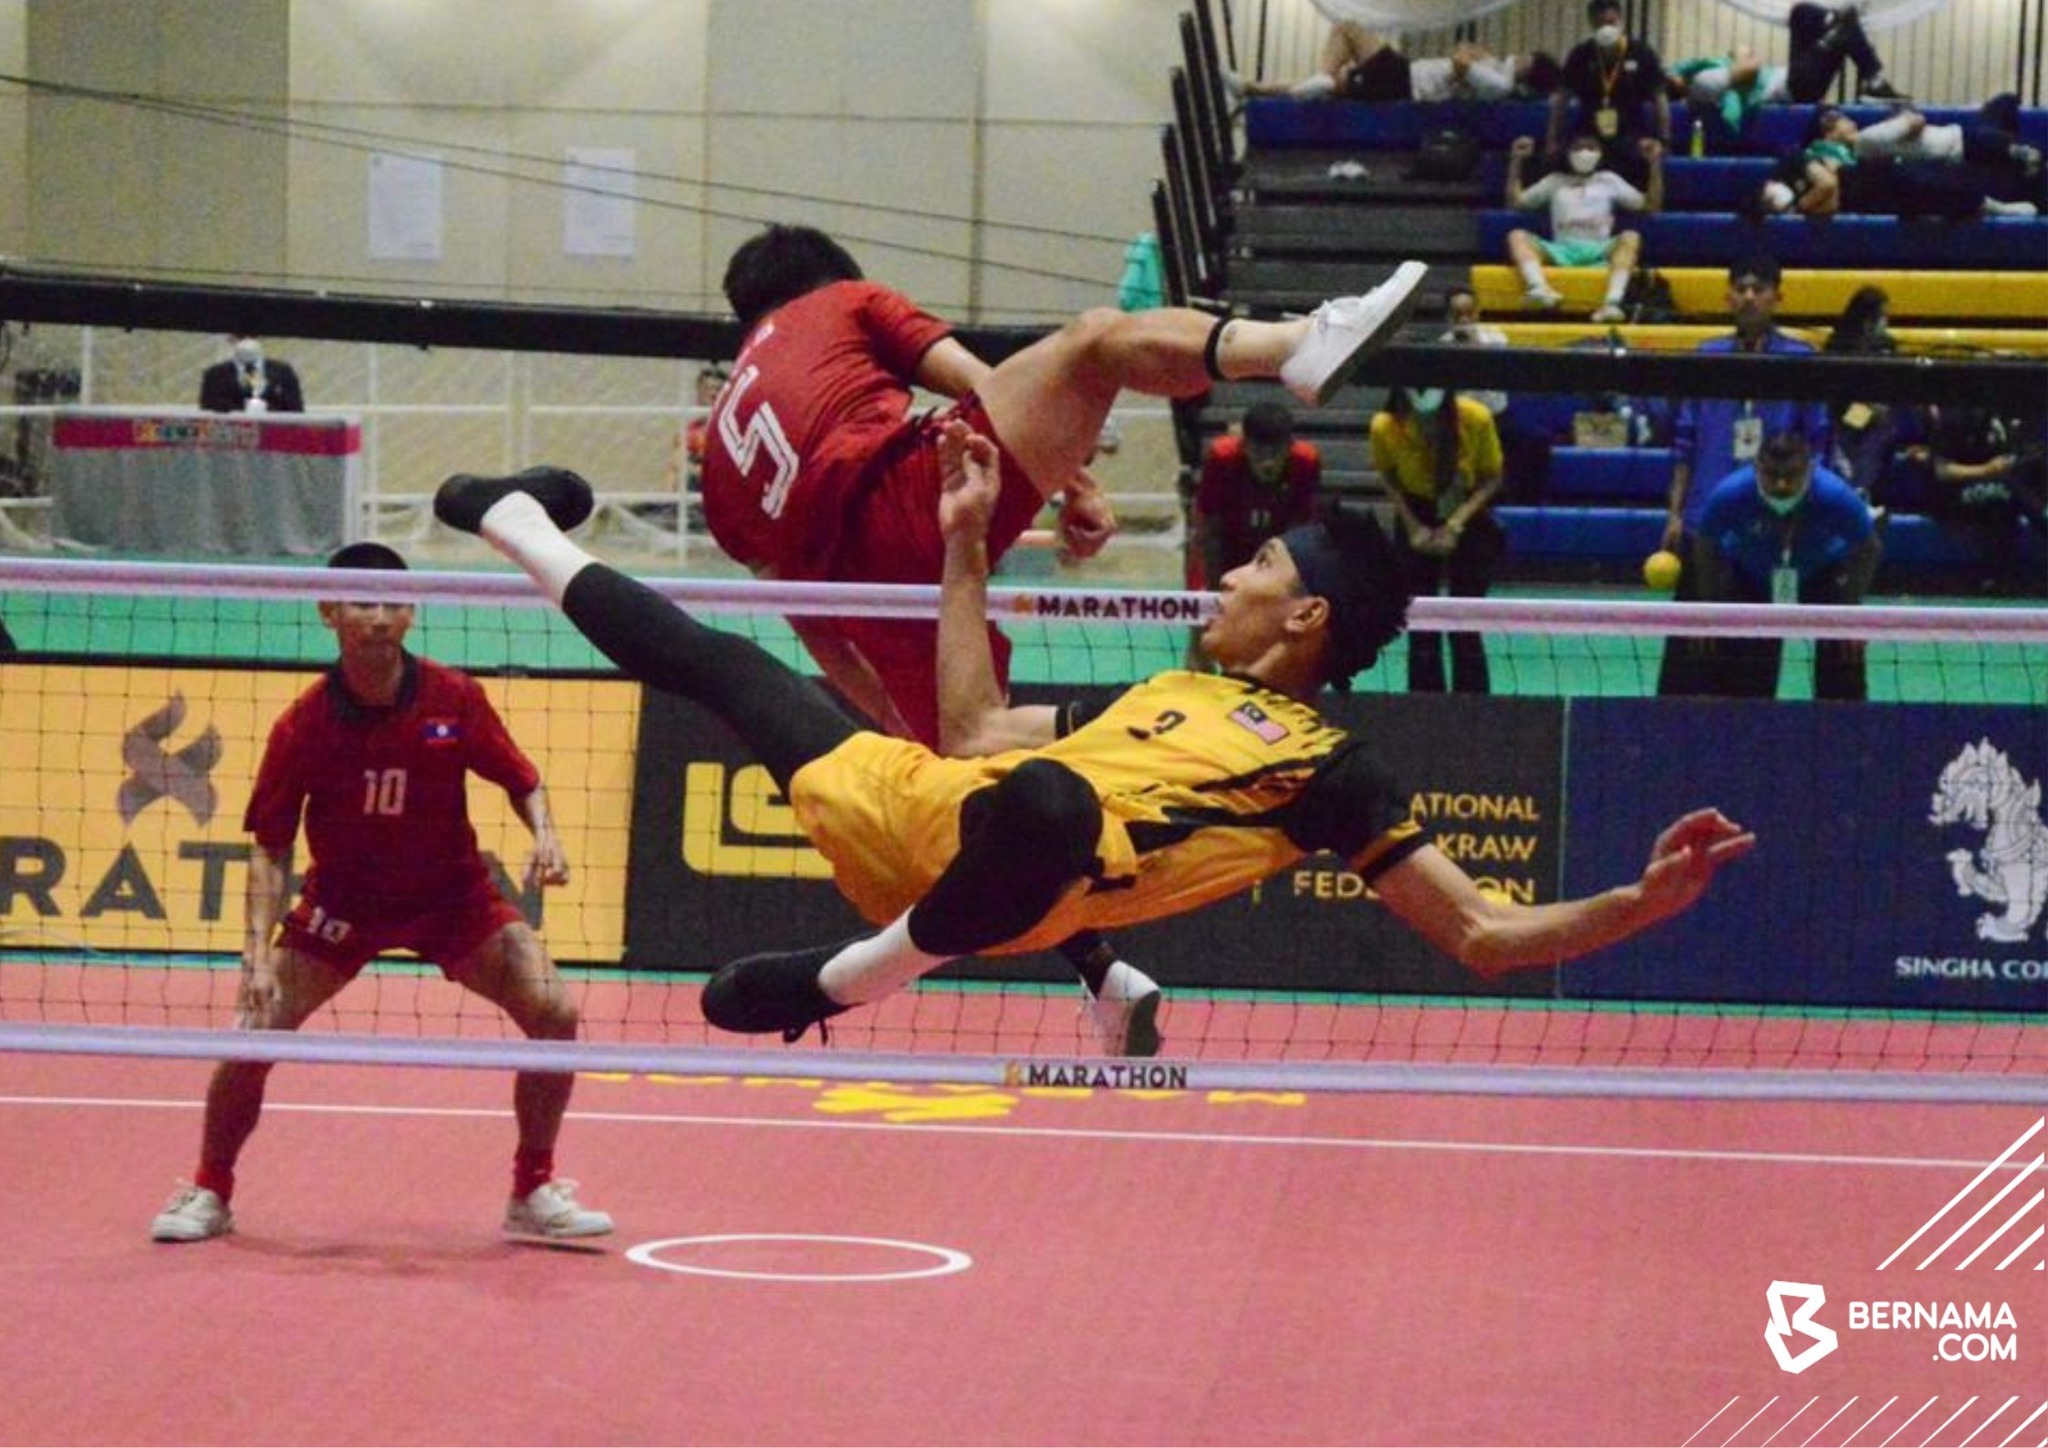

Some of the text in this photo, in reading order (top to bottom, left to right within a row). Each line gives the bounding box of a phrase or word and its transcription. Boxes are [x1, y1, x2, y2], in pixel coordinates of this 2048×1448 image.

[718, 364, 800, 520] 5
[1037, 595, 1200, 620] MARATHON
[363, 768, 408, 816] 10
[1409, 792, 1540, 821] ATIONAL
[1435, 833, 1538, 861] KRAW
[1895, 954, 2048, 981] SINGHA CO
[1028, 1063, 1188, 1089] MARATHON
